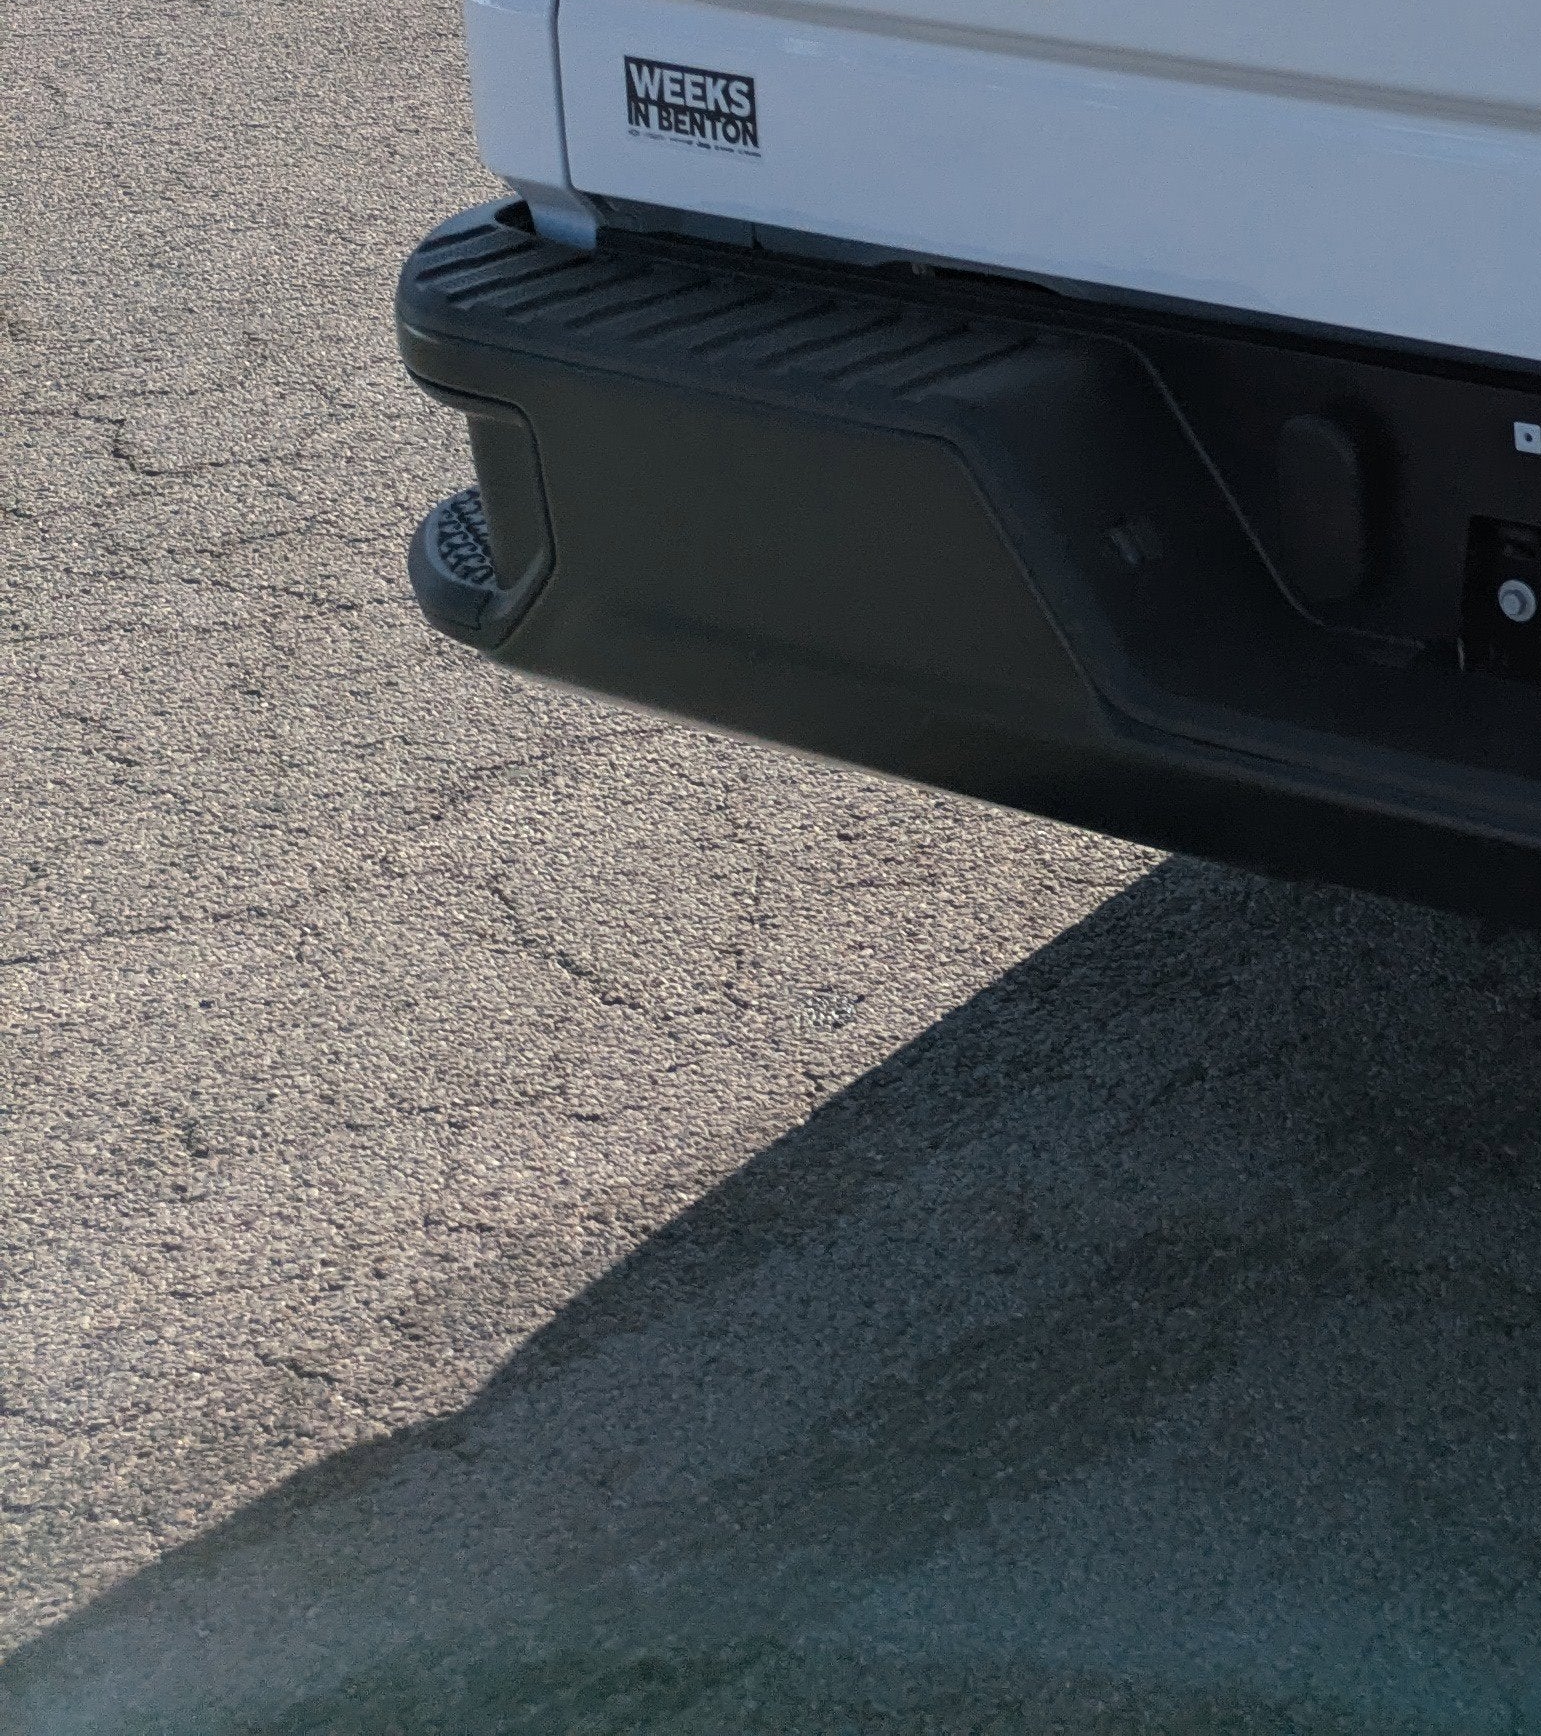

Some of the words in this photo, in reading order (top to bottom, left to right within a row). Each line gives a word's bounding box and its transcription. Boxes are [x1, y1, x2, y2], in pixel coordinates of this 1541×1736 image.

[629, 63, 751, 118] WEEKS
[628, 100, 651, 129] IN
[657, 106, 760, 149] BENTON
